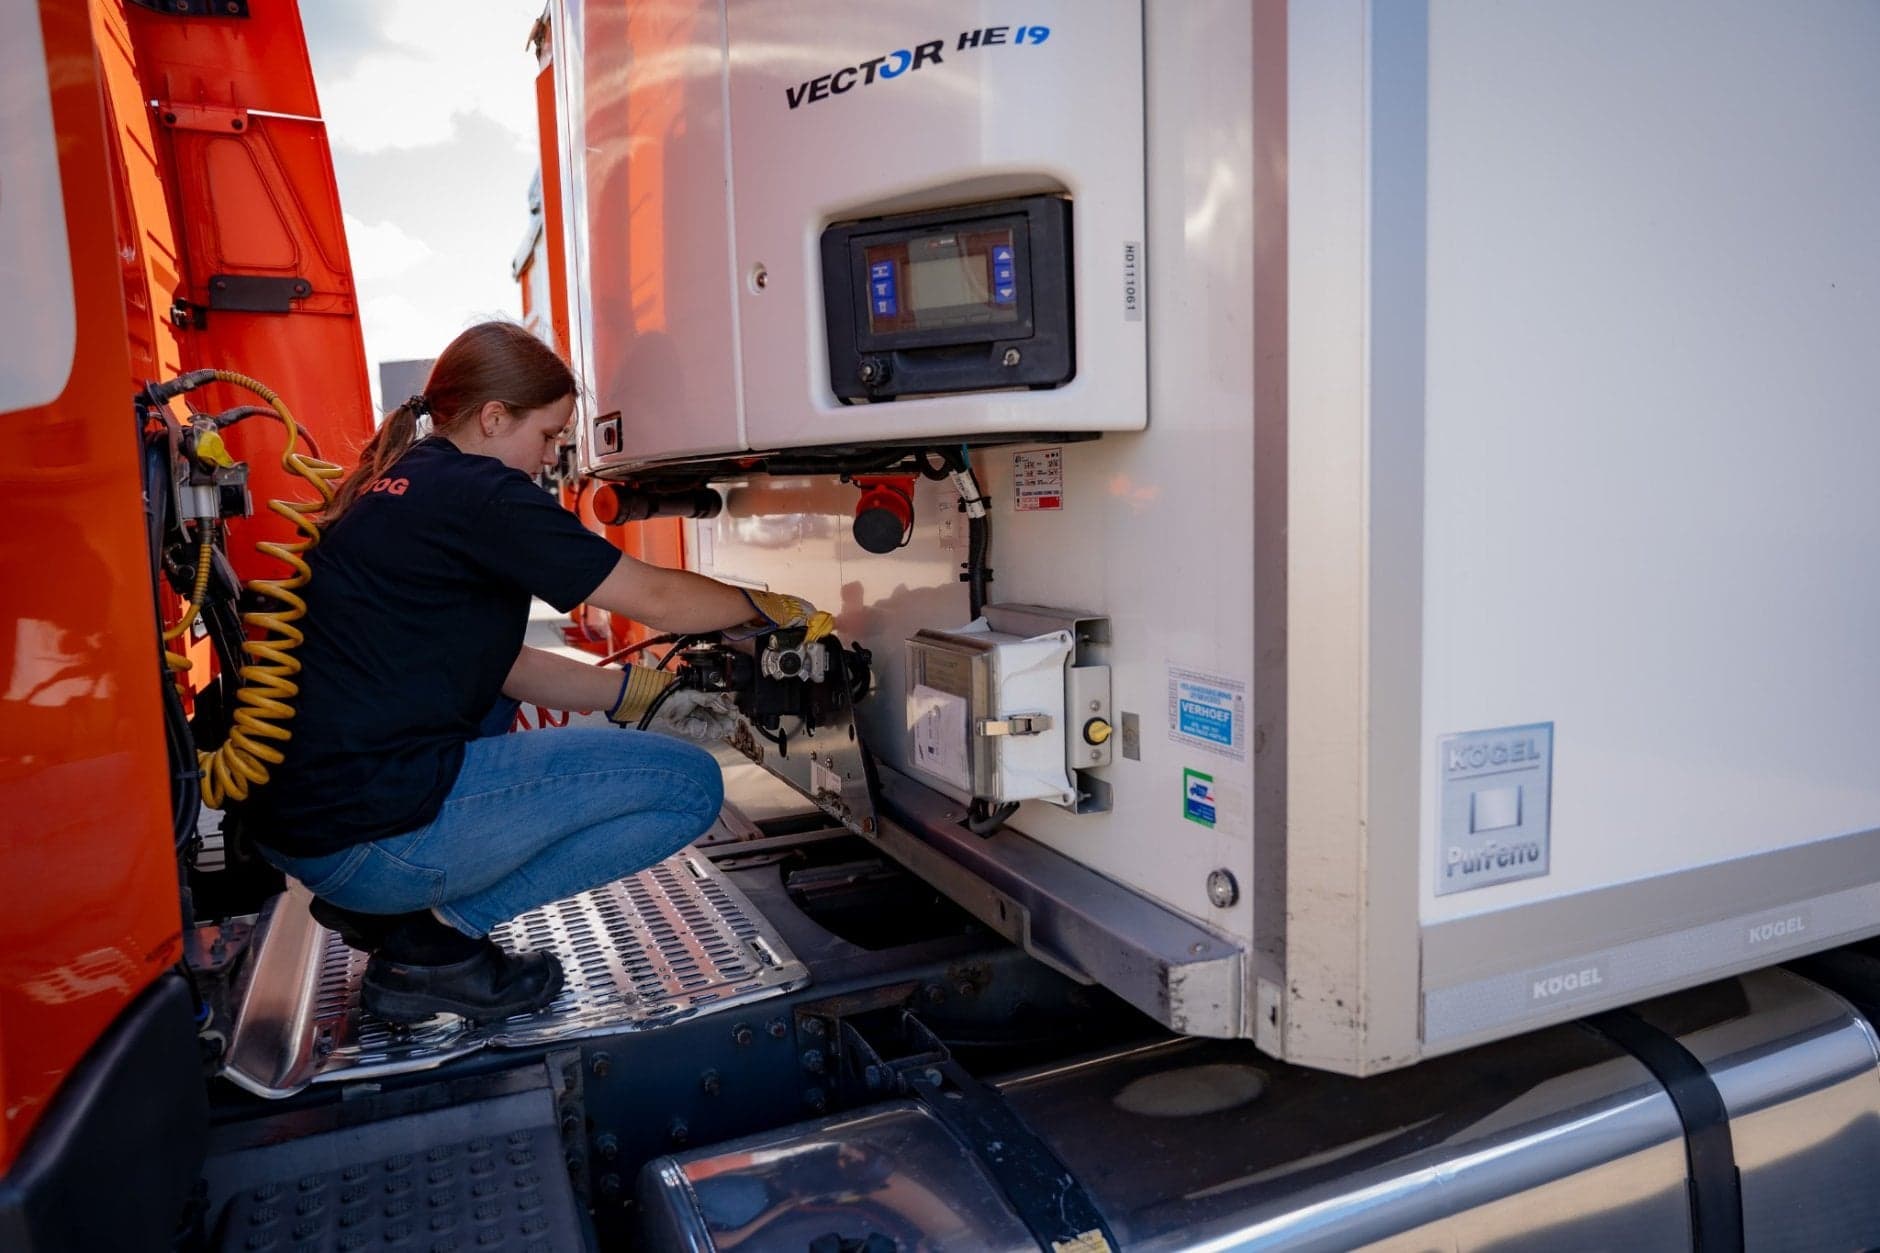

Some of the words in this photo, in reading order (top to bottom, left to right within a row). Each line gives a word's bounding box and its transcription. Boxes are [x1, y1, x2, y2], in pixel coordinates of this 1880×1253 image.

[785, 39, 945, 110] VECTOR
[956, 26, 1010, 51] HE
[1014, 25, 1051, 45] 19
[1181, 700, 1231, 722] VERHOEF
[1446, 841, 1539, 877] PurFerro
